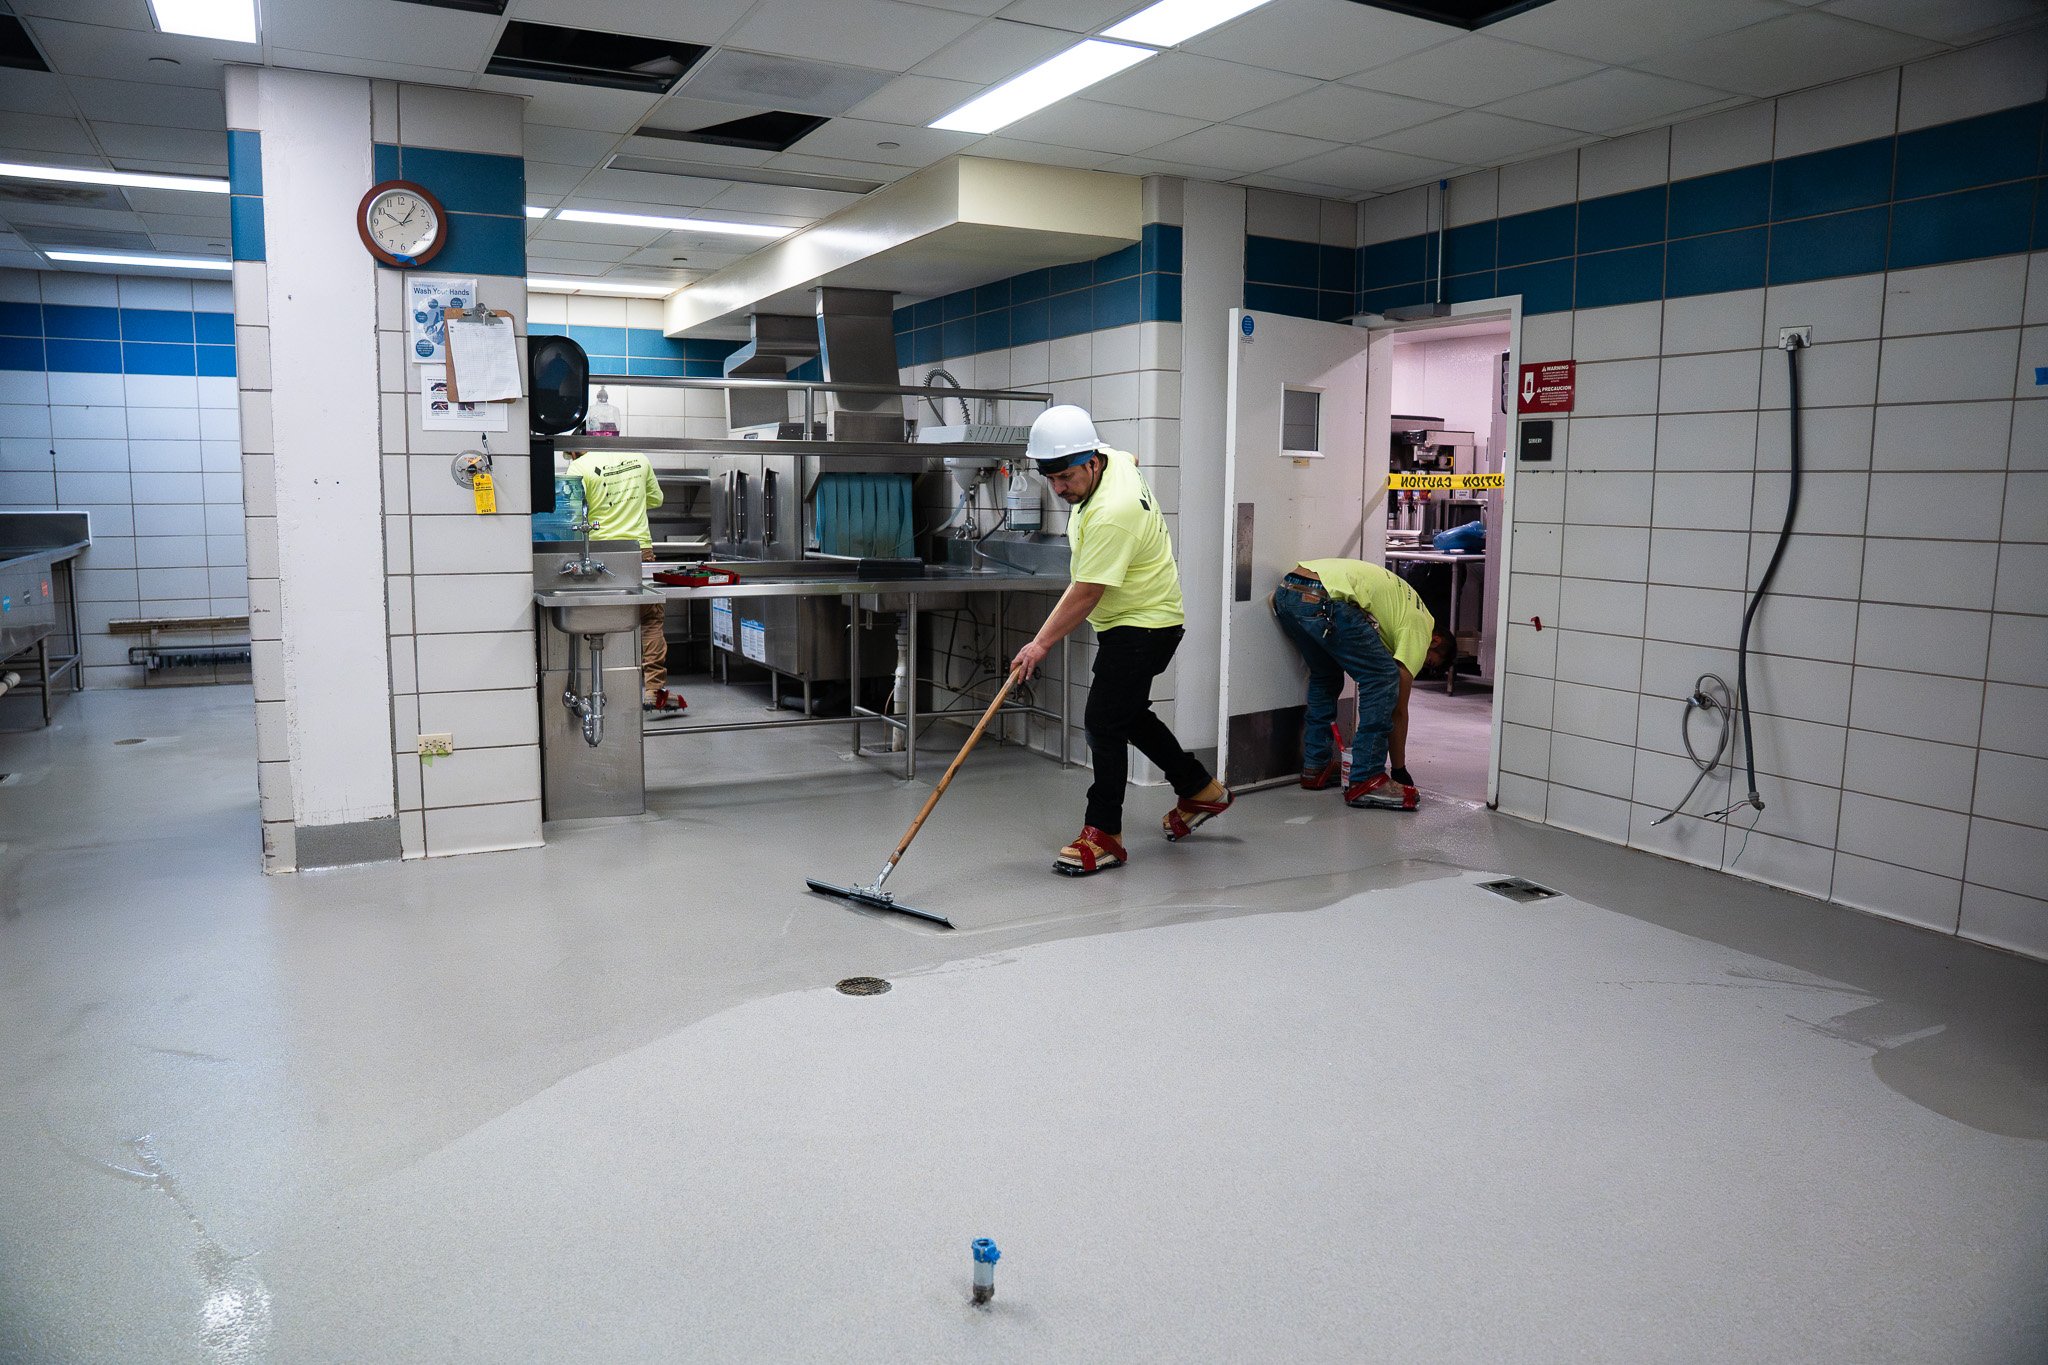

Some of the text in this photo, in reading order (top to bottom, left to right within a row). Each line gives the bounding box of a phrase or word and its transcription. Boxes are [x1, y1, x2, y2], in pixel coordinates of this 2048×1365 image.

[386, 198, 393, 208] 11
[397, 196, 405, 206] 12
[378, 206, 386, 216] 10
[420, 208, 426, 218] 2
[373, 217, 379, 226] 9
[425, 221, 430, 230] 3
[378, 230, 384, 239] 8
[400, 243, 406, 251] 6
[413, 287, 432, 295] Wash
